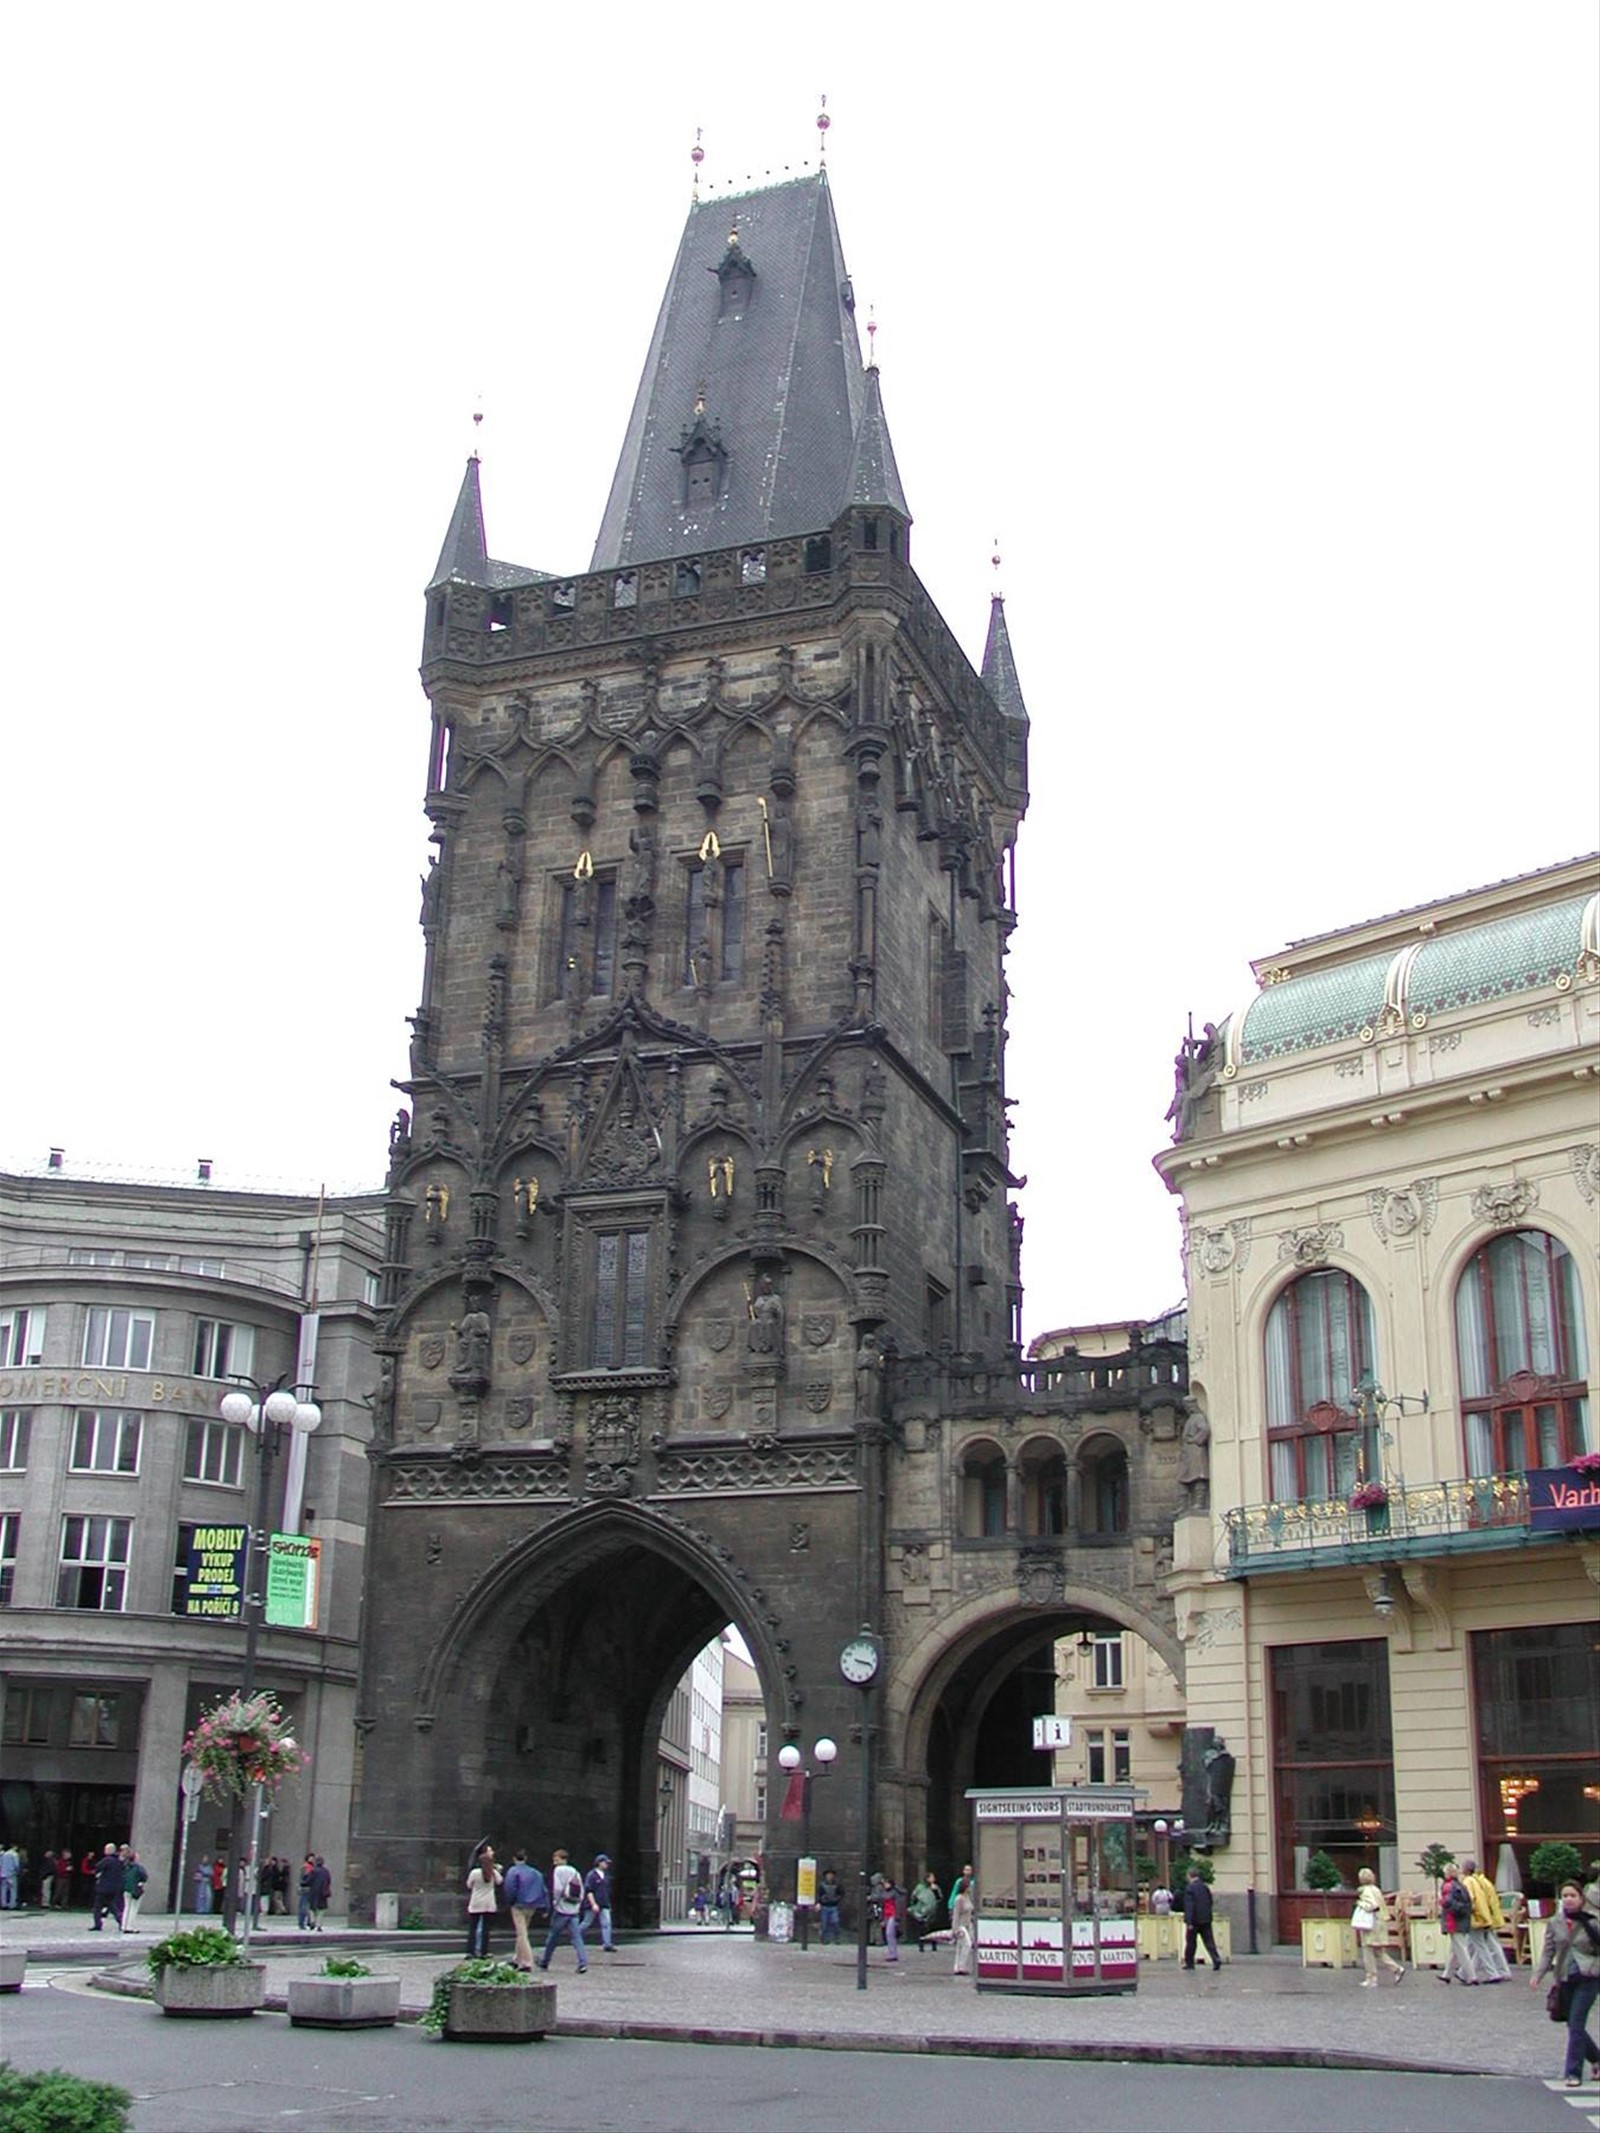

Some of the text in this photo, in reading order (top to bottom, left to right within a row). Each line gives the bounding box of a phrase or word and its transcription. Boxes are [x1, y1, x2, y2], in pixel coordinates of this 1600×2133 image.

[193, 1528, 245, 1550] MOBILY
[198, 1568, 235, 1583] PRODEJ
[187, 1600, 200, 1614] NA
[978, 1801, 1060, 1813] SIGHTSEEING TOURS
[979, 1952, 1058, 1963] MARTIN TOUR
[1072, 1951, 1134, 1962] TOUR MARTIN
